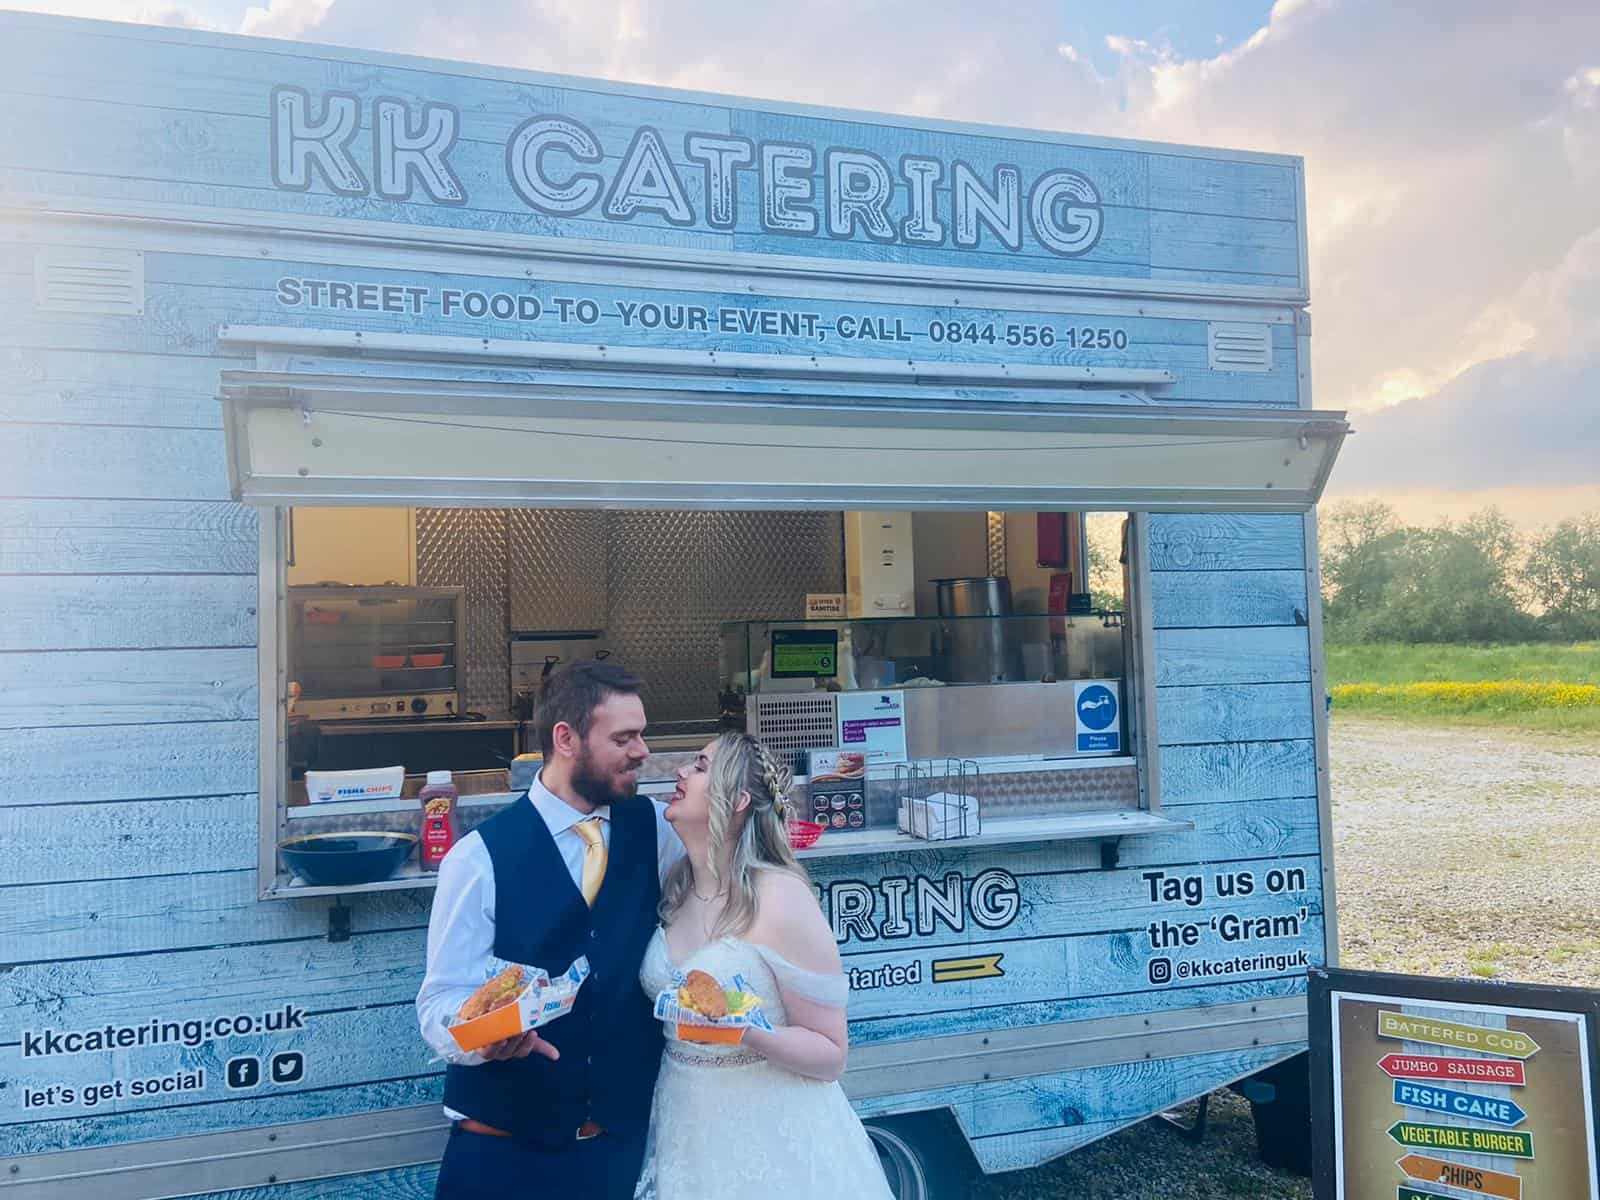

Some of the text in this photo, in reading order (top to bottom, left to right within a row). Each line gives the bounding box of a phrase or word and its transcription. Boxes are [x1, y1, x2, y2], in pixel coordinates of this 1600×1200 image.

[270, 84, 1105, 257] KK CATERING
[276, 278, 1128, 350] STREET FOOD TO YOUR EVENT, CALL 0844 556 1250
[1142, 867, 1305, 907] Tag us on
[814, 868, 1020, 944] RING
[1149, 920, 1200, 949] the
[848, 959, 922, 990] tarted
[1176, 949, 1309, 979] @kkcateringuk
[23, 1004, 304, 1057] kkcatering.co.uk
[1385, 1017, 1527, 1051] BATTERED COD
[1391, 1059, 1516, 1078] JUMBO SAUSAGE
[24, 1069, 205, 1108] let’s get social
[1401, 1085, 1511, 1121] FISH CAKE
[1401, 1125, 1525, 1153] VEGETABLE BURGER
[1440, 1164, 1484, 1189] CHIPS
